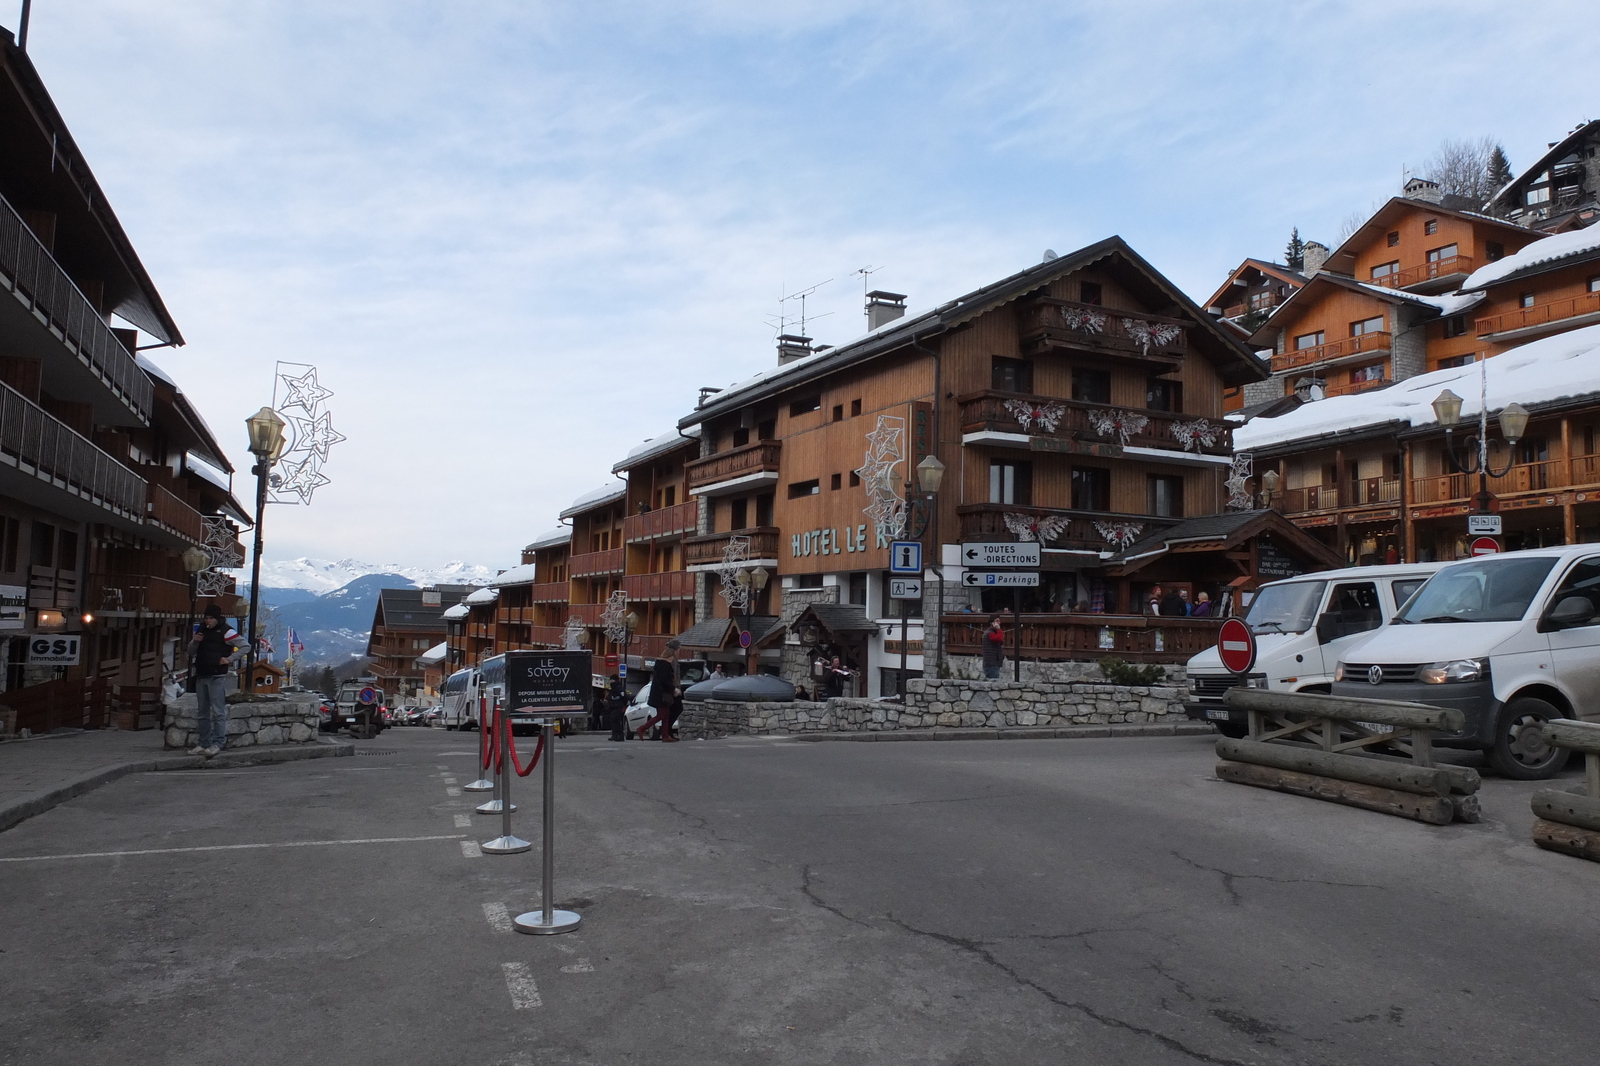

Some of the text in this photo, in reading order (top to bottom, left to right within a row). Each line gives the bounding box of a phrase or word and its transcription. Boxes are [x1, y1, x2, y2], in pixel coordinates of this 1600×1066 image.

[791, 528, 840, 558] HOTEL
[846, 524, 867, 552] LE
[997, 575, 1037, 585] Parkings
[32, 639, 77, 655] GSI
[540, 659, 554, 667] LE
